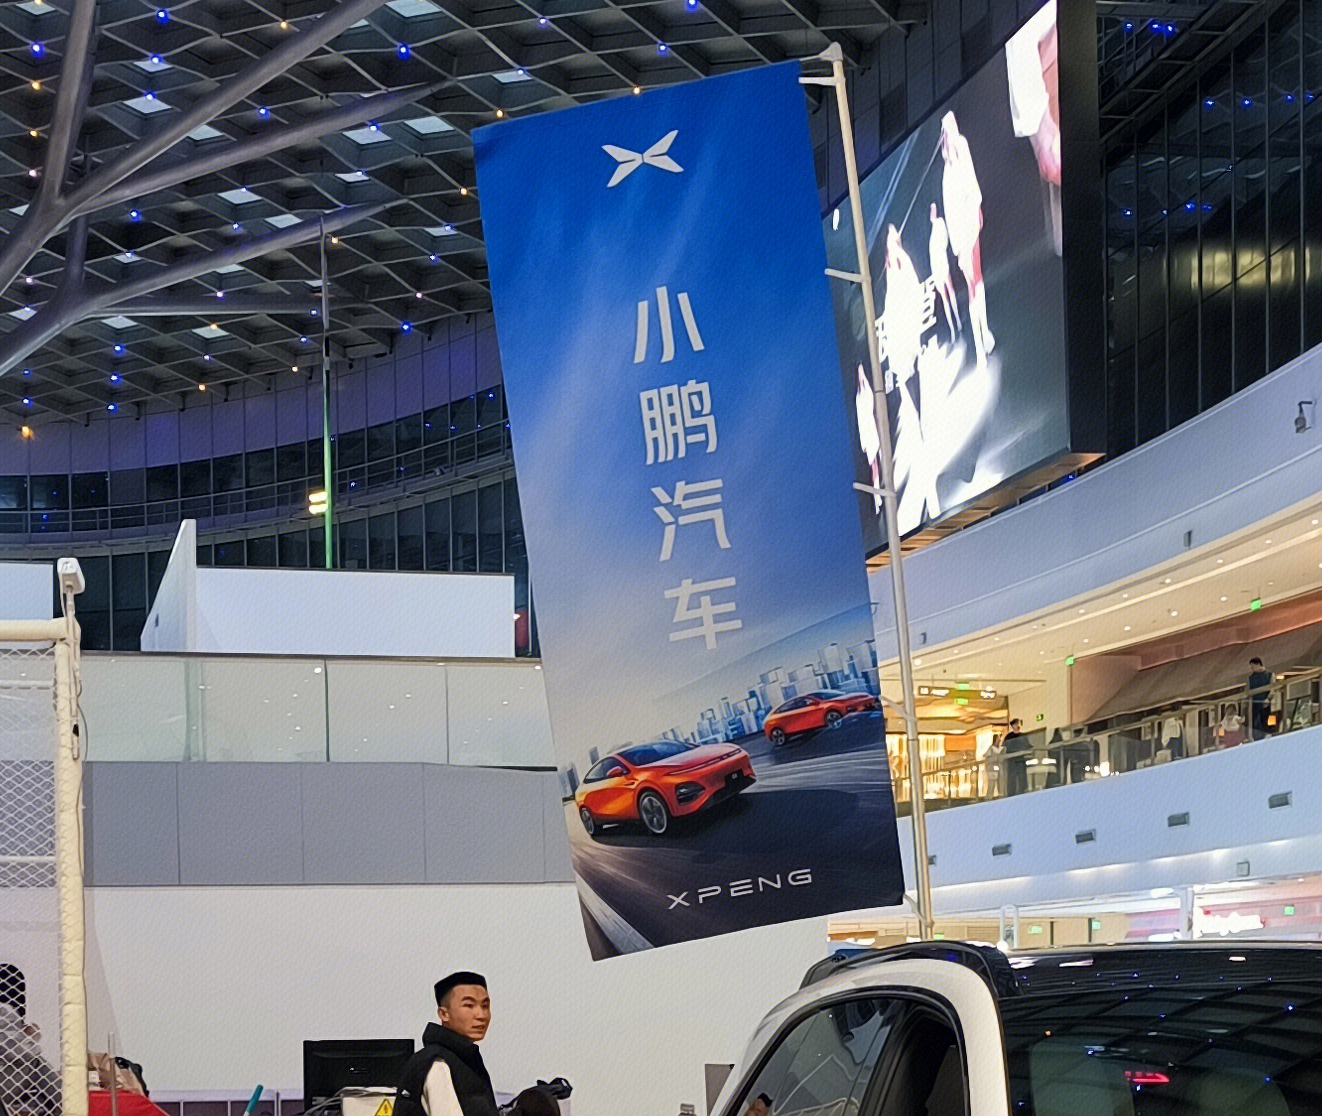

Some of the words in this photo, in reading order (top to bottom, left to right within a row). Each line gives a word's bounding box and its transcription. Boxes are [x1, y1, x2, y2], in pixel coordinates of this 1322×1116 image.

[633, 285, 743, 650] 小鹏汽车
[666, 868, 813, 910] XPENG
